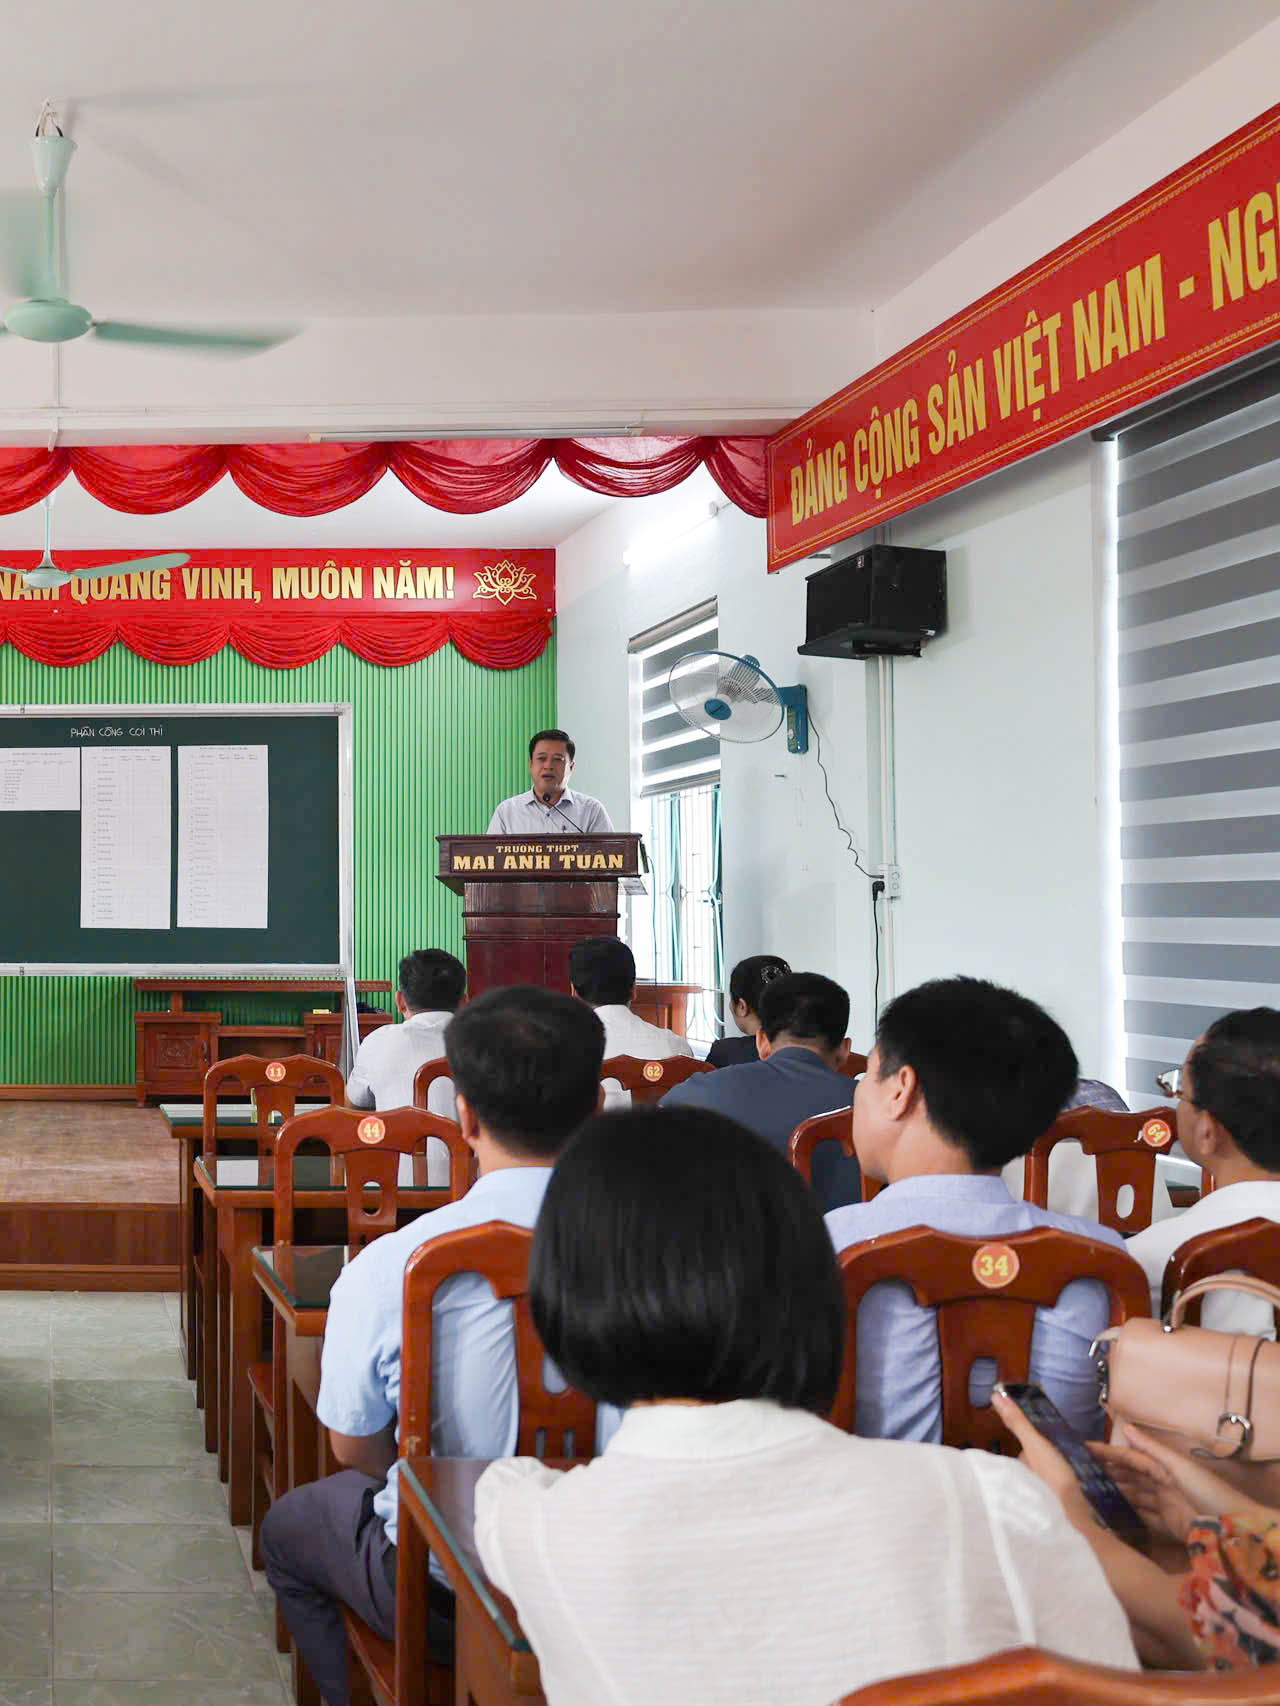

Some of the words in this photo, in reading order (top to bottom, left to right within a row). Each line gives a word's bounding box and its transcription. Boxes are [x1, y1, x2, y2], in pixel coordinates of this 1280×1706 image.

[790, 439, 848, 527] ĐẢNG
[853, 397, 921, 499] CỘNG
[927, 350, 987, 456] SẢN
[993, 309, 1063, 423] VIỆT
[1072, 252, 1166, 381] NAM
[1208, 182, 1280, 311] NG
[70, 568, 171, 605] QUANG
[182, 566, 262, 604] VINH,
[272, 560, 364, 601] MUÔN
[373, 559, 455, 600] NĂM!
[70, 726, 95, 738] PHÂN
[98, 726, 124, 737] CÔNG
[128, 726, 145, 737] COI
[148, 724, 163, 737] THI
[546, 844, 580, 853] THPT
[453, 855, 495, 870] MAI
[503, 855, 551, 870] ANH
[270, 1067, 282, 1077] 11
[647, 1066, 660, 1077] 62
[363, 1122, 381, 1137] 44
[980, 1255, 1009, 1276] 34
